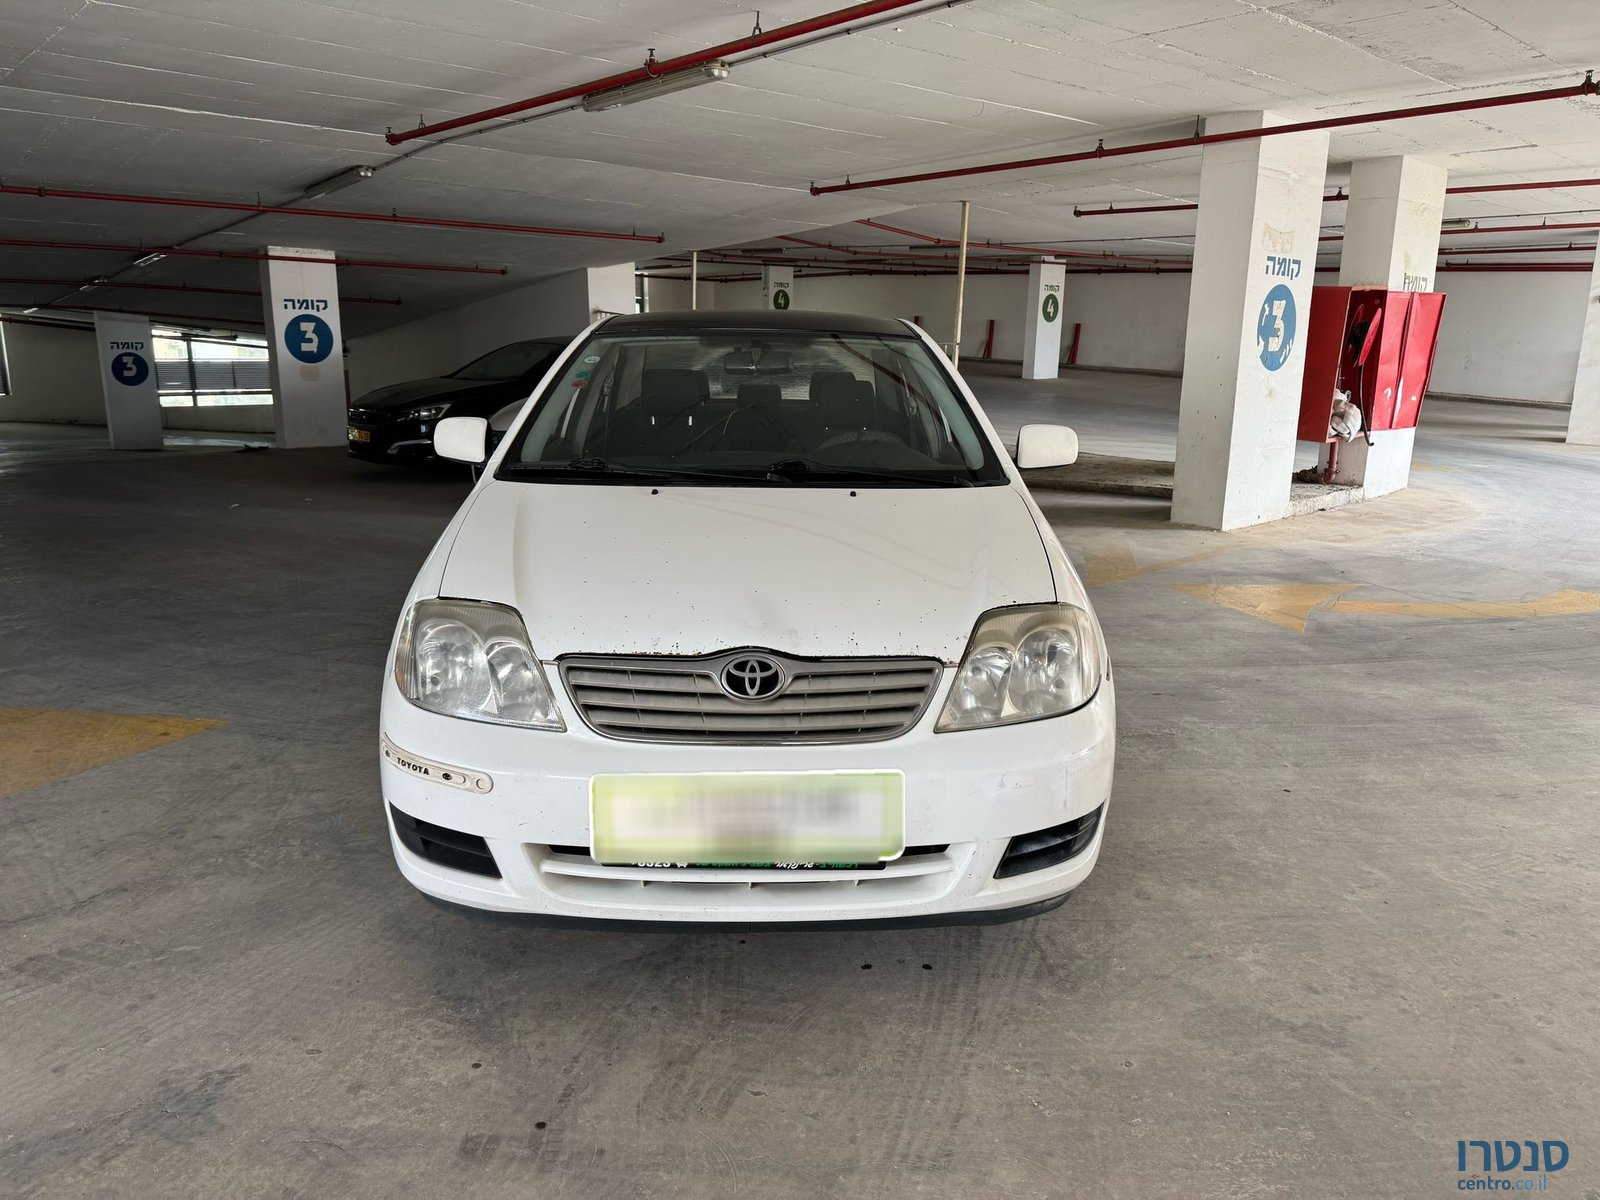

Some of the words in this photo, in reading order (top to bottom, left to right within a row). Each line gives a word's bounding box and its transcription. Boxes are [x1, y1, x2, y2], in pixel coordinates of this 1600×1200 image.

[1264, 255, 1302, 281] קומה
[773, 281, 790, 289] קומה
[1043, 284, 1060, 293] קומה
[283, 298, 328, 312] קומה
[777, 292, 785, 307] 4
[1046, 298, 1055, 317] 4
[1267, 299, 1287, 352] 3
[109, 341, 145, 351] קומה
[299, 321, 319, 354] 3
[121, 356, 138, 377] 3
[396, 757, 430, 776] TOYOTA
